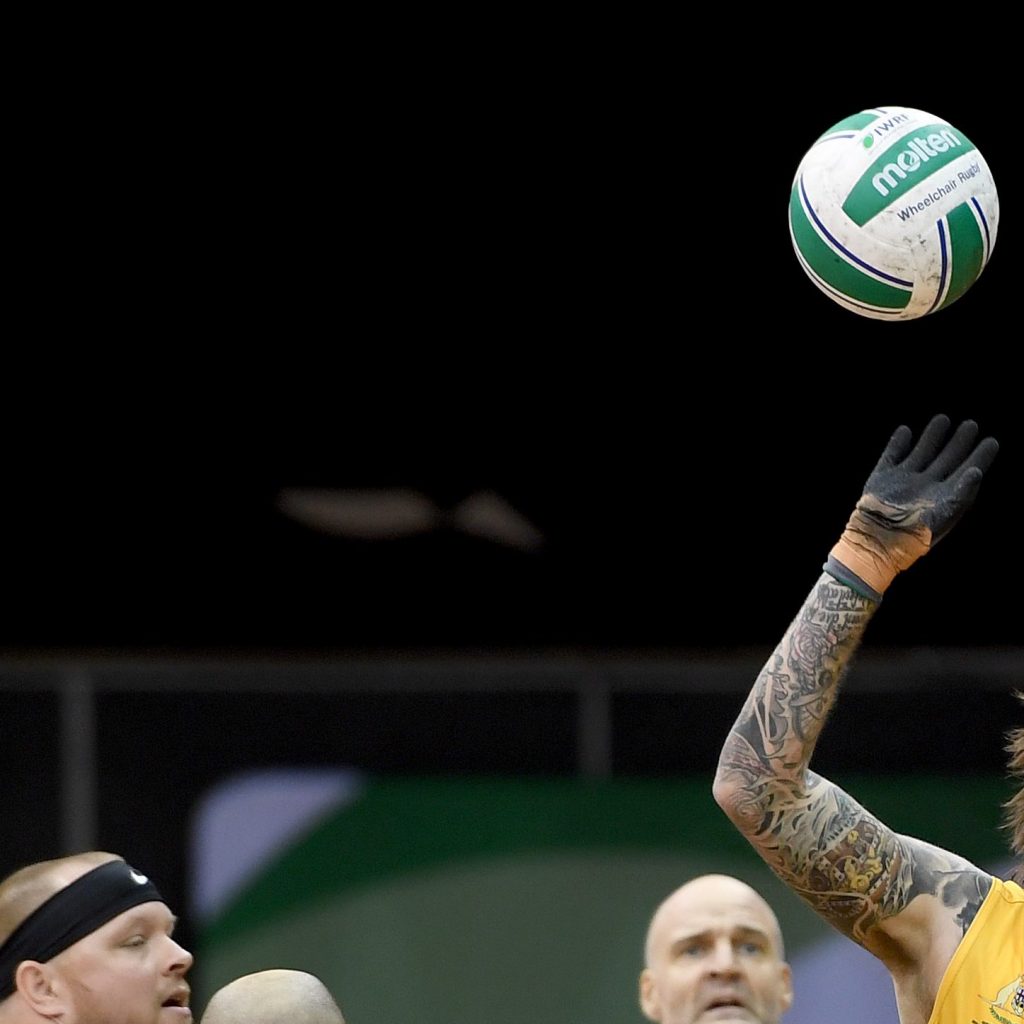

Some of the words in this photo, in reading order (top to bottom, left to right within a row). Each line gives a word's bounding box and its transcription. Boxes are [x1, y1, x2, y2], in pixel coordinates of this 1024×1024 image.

[872, 130, 962, 197] molten
[897, 180, 957, 222] Wheelchair
[957, 162, 982, 184] Rugby
